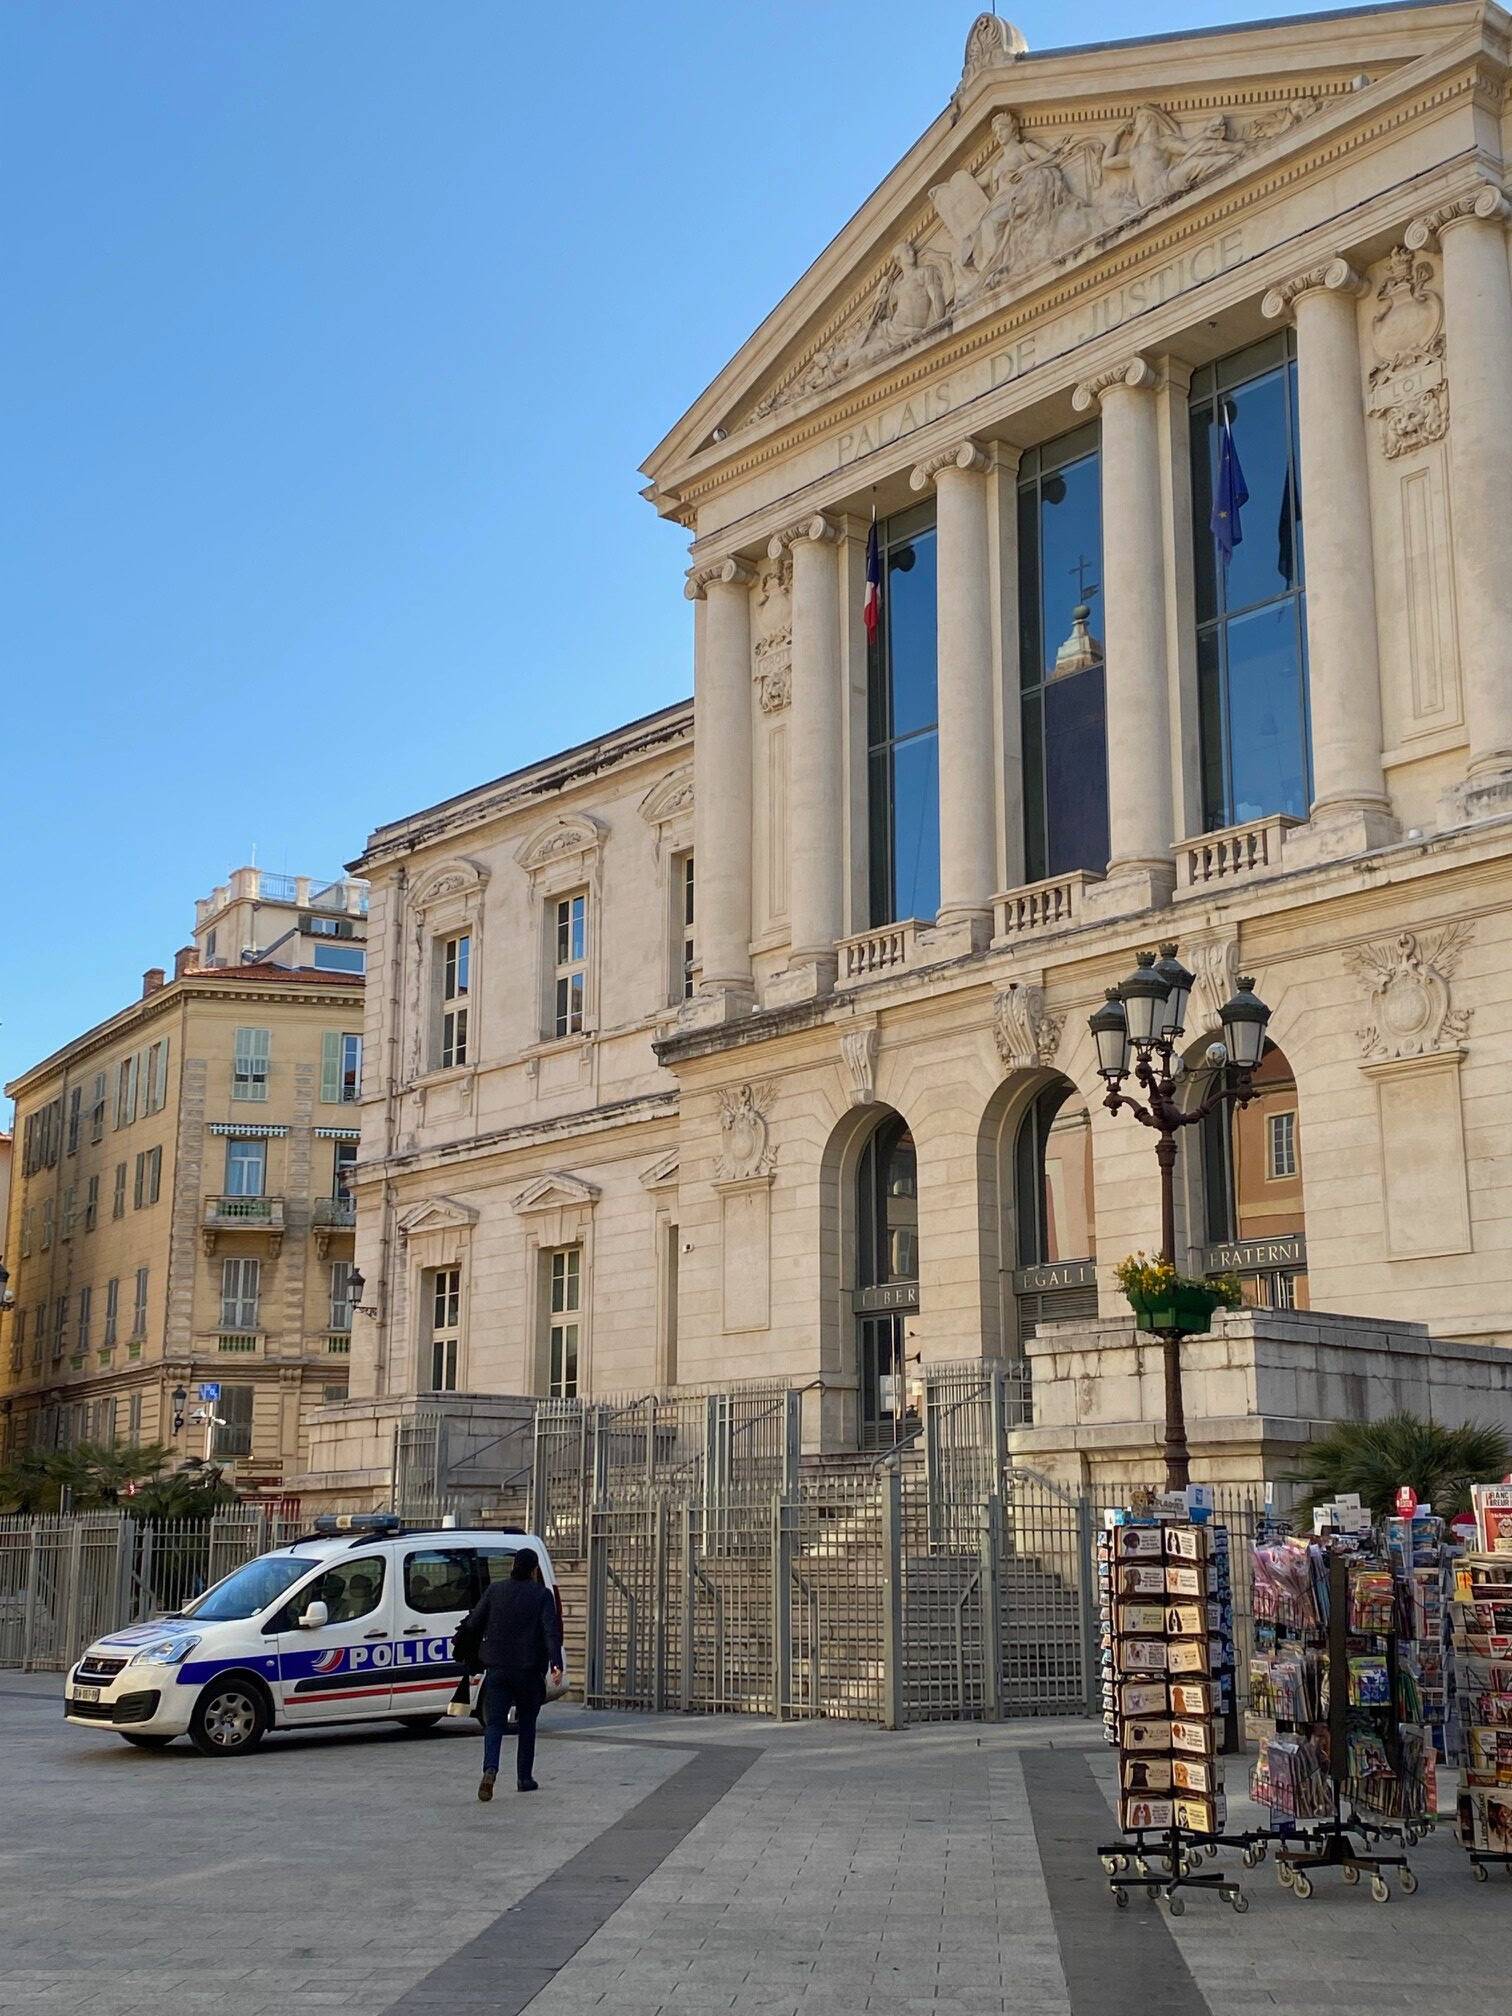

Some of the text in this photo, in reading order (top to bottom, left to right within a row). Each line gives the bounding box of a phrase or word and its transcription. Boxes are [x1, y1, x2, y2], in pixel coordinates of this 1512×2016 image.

[837, 229, 1245, 466] PALAIS DE JUSTICE
